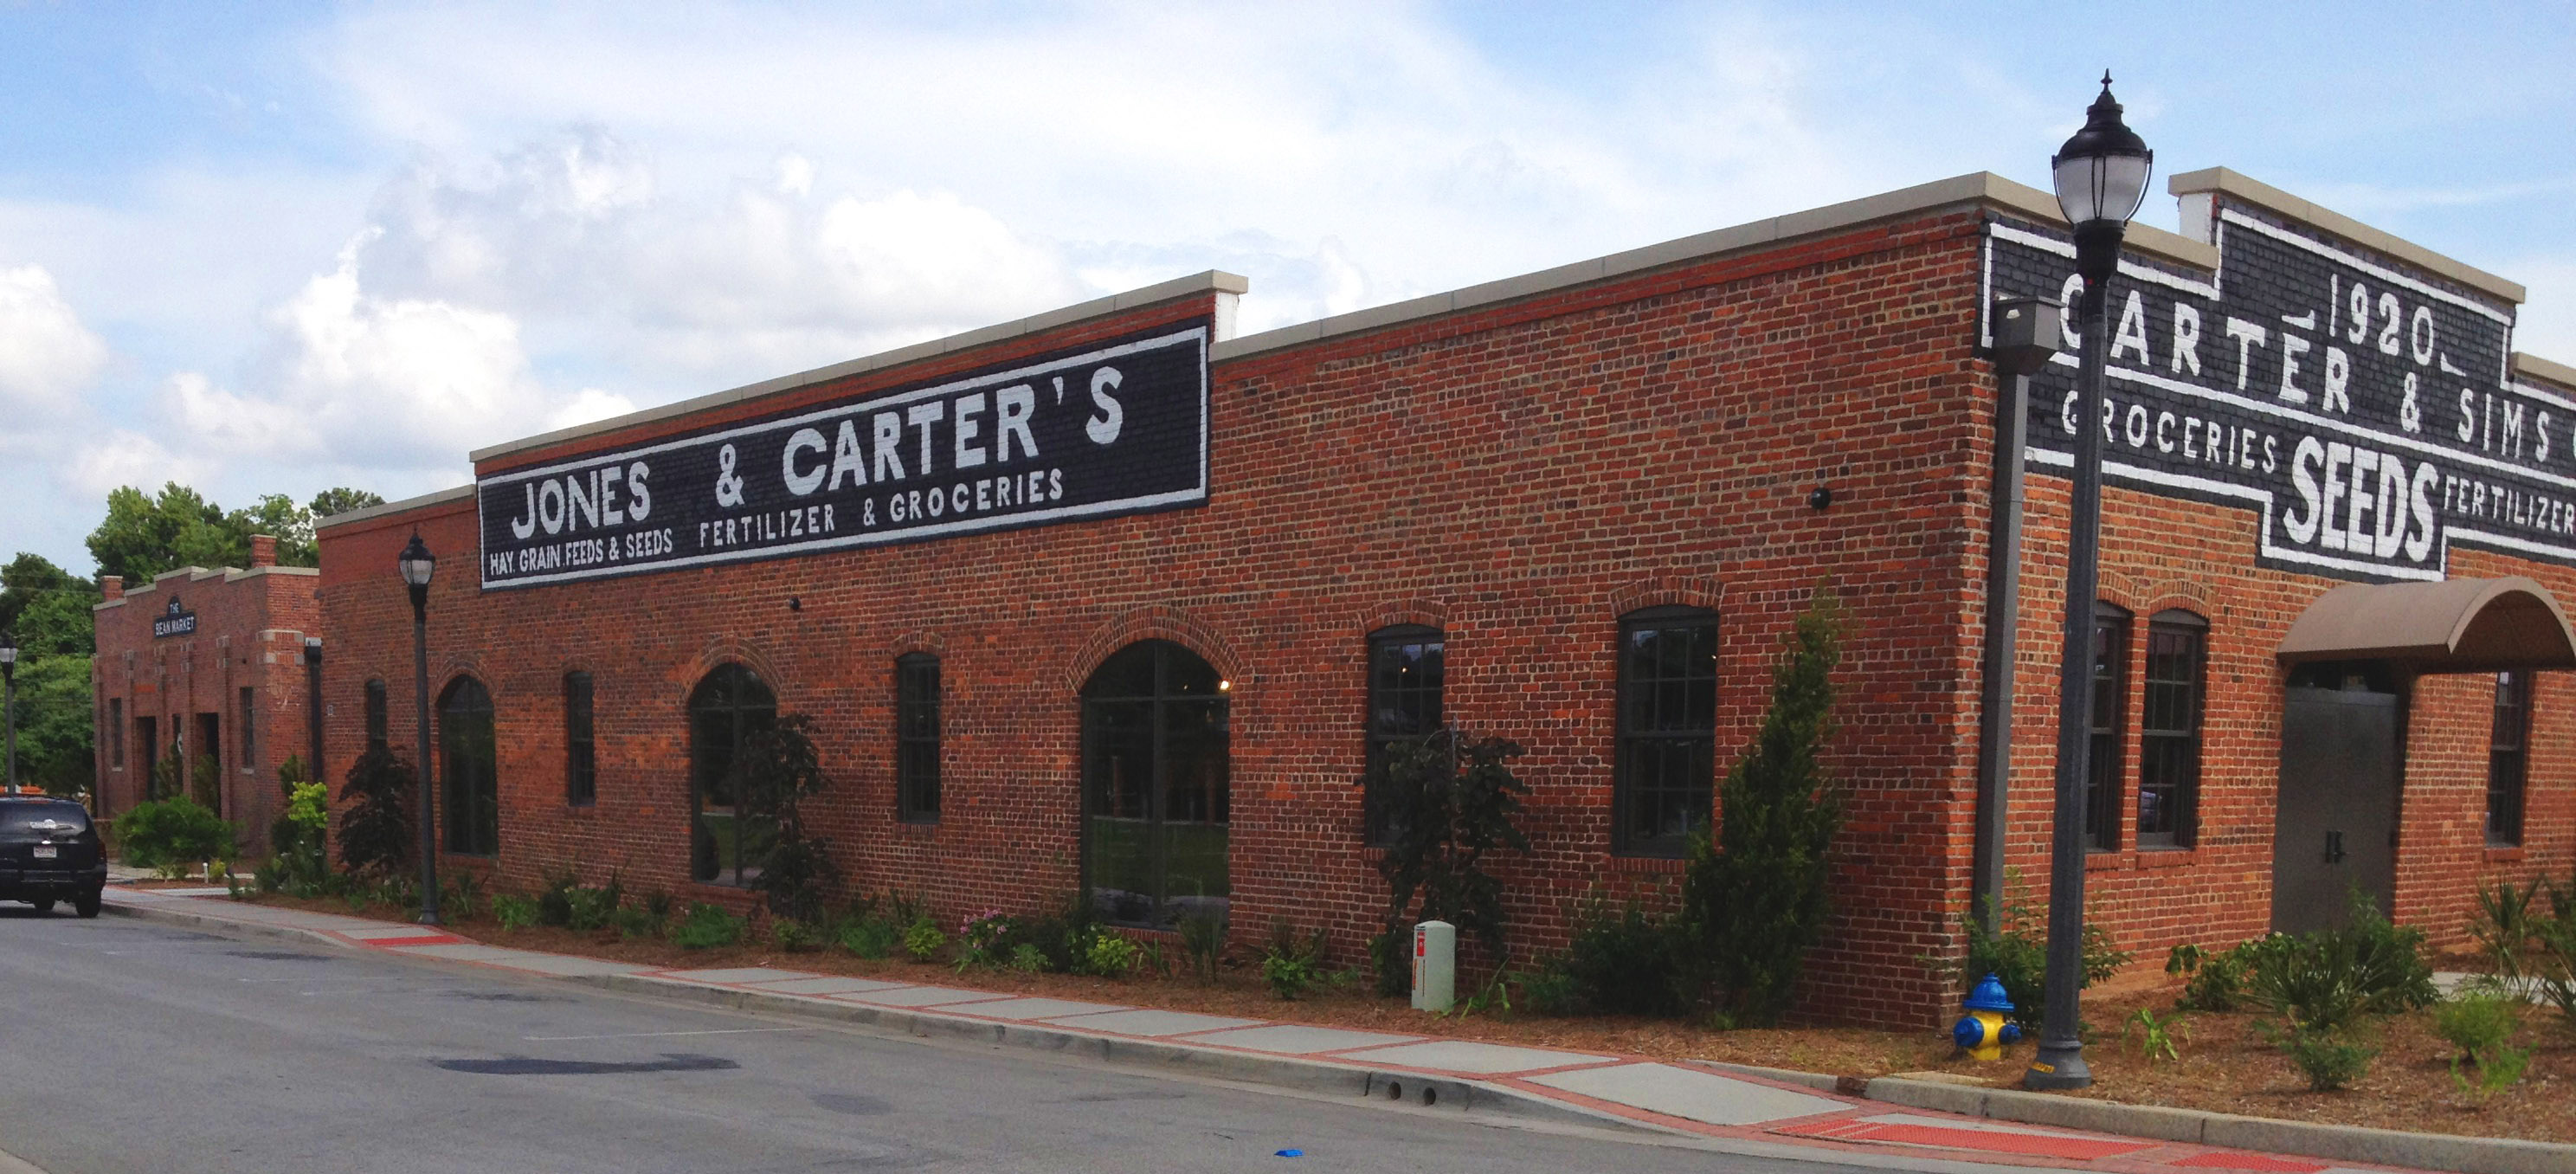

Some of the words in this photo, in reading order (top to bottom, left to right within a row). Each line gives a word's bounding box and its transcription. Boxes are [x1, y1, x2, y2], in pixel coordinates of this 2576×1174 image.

[2329, 273, 2434, 365] 1920
[2060, 273, 2351, 415] CARTER
[2400, 372, 2420, 433] &
[2457, 387, 2550, 462] SIMS
[511, 461, 651, 539] JONES
[715, 443, 745, 508] &
[782, 365, 1124, 496] CARTER'S
[2062, 390, 2277, 474] GROCERIES
[699, 504, 836, 548] FERTILIZER
[863, 498, 875, 526] &
[889, 468, 1064, 523] GROCERIES
[2283, 435, 2438, 563] SEEDS
[2444, 475, 2574, 535] FERTILIZER
[566, 538, 604, 567] FEEDS
[609, 536, 621, 561] &
[626, 528, 673, 560] SEEDS
[156, 622, 171, 635] BEAN
[171, 616, 195, 634] MARKET
